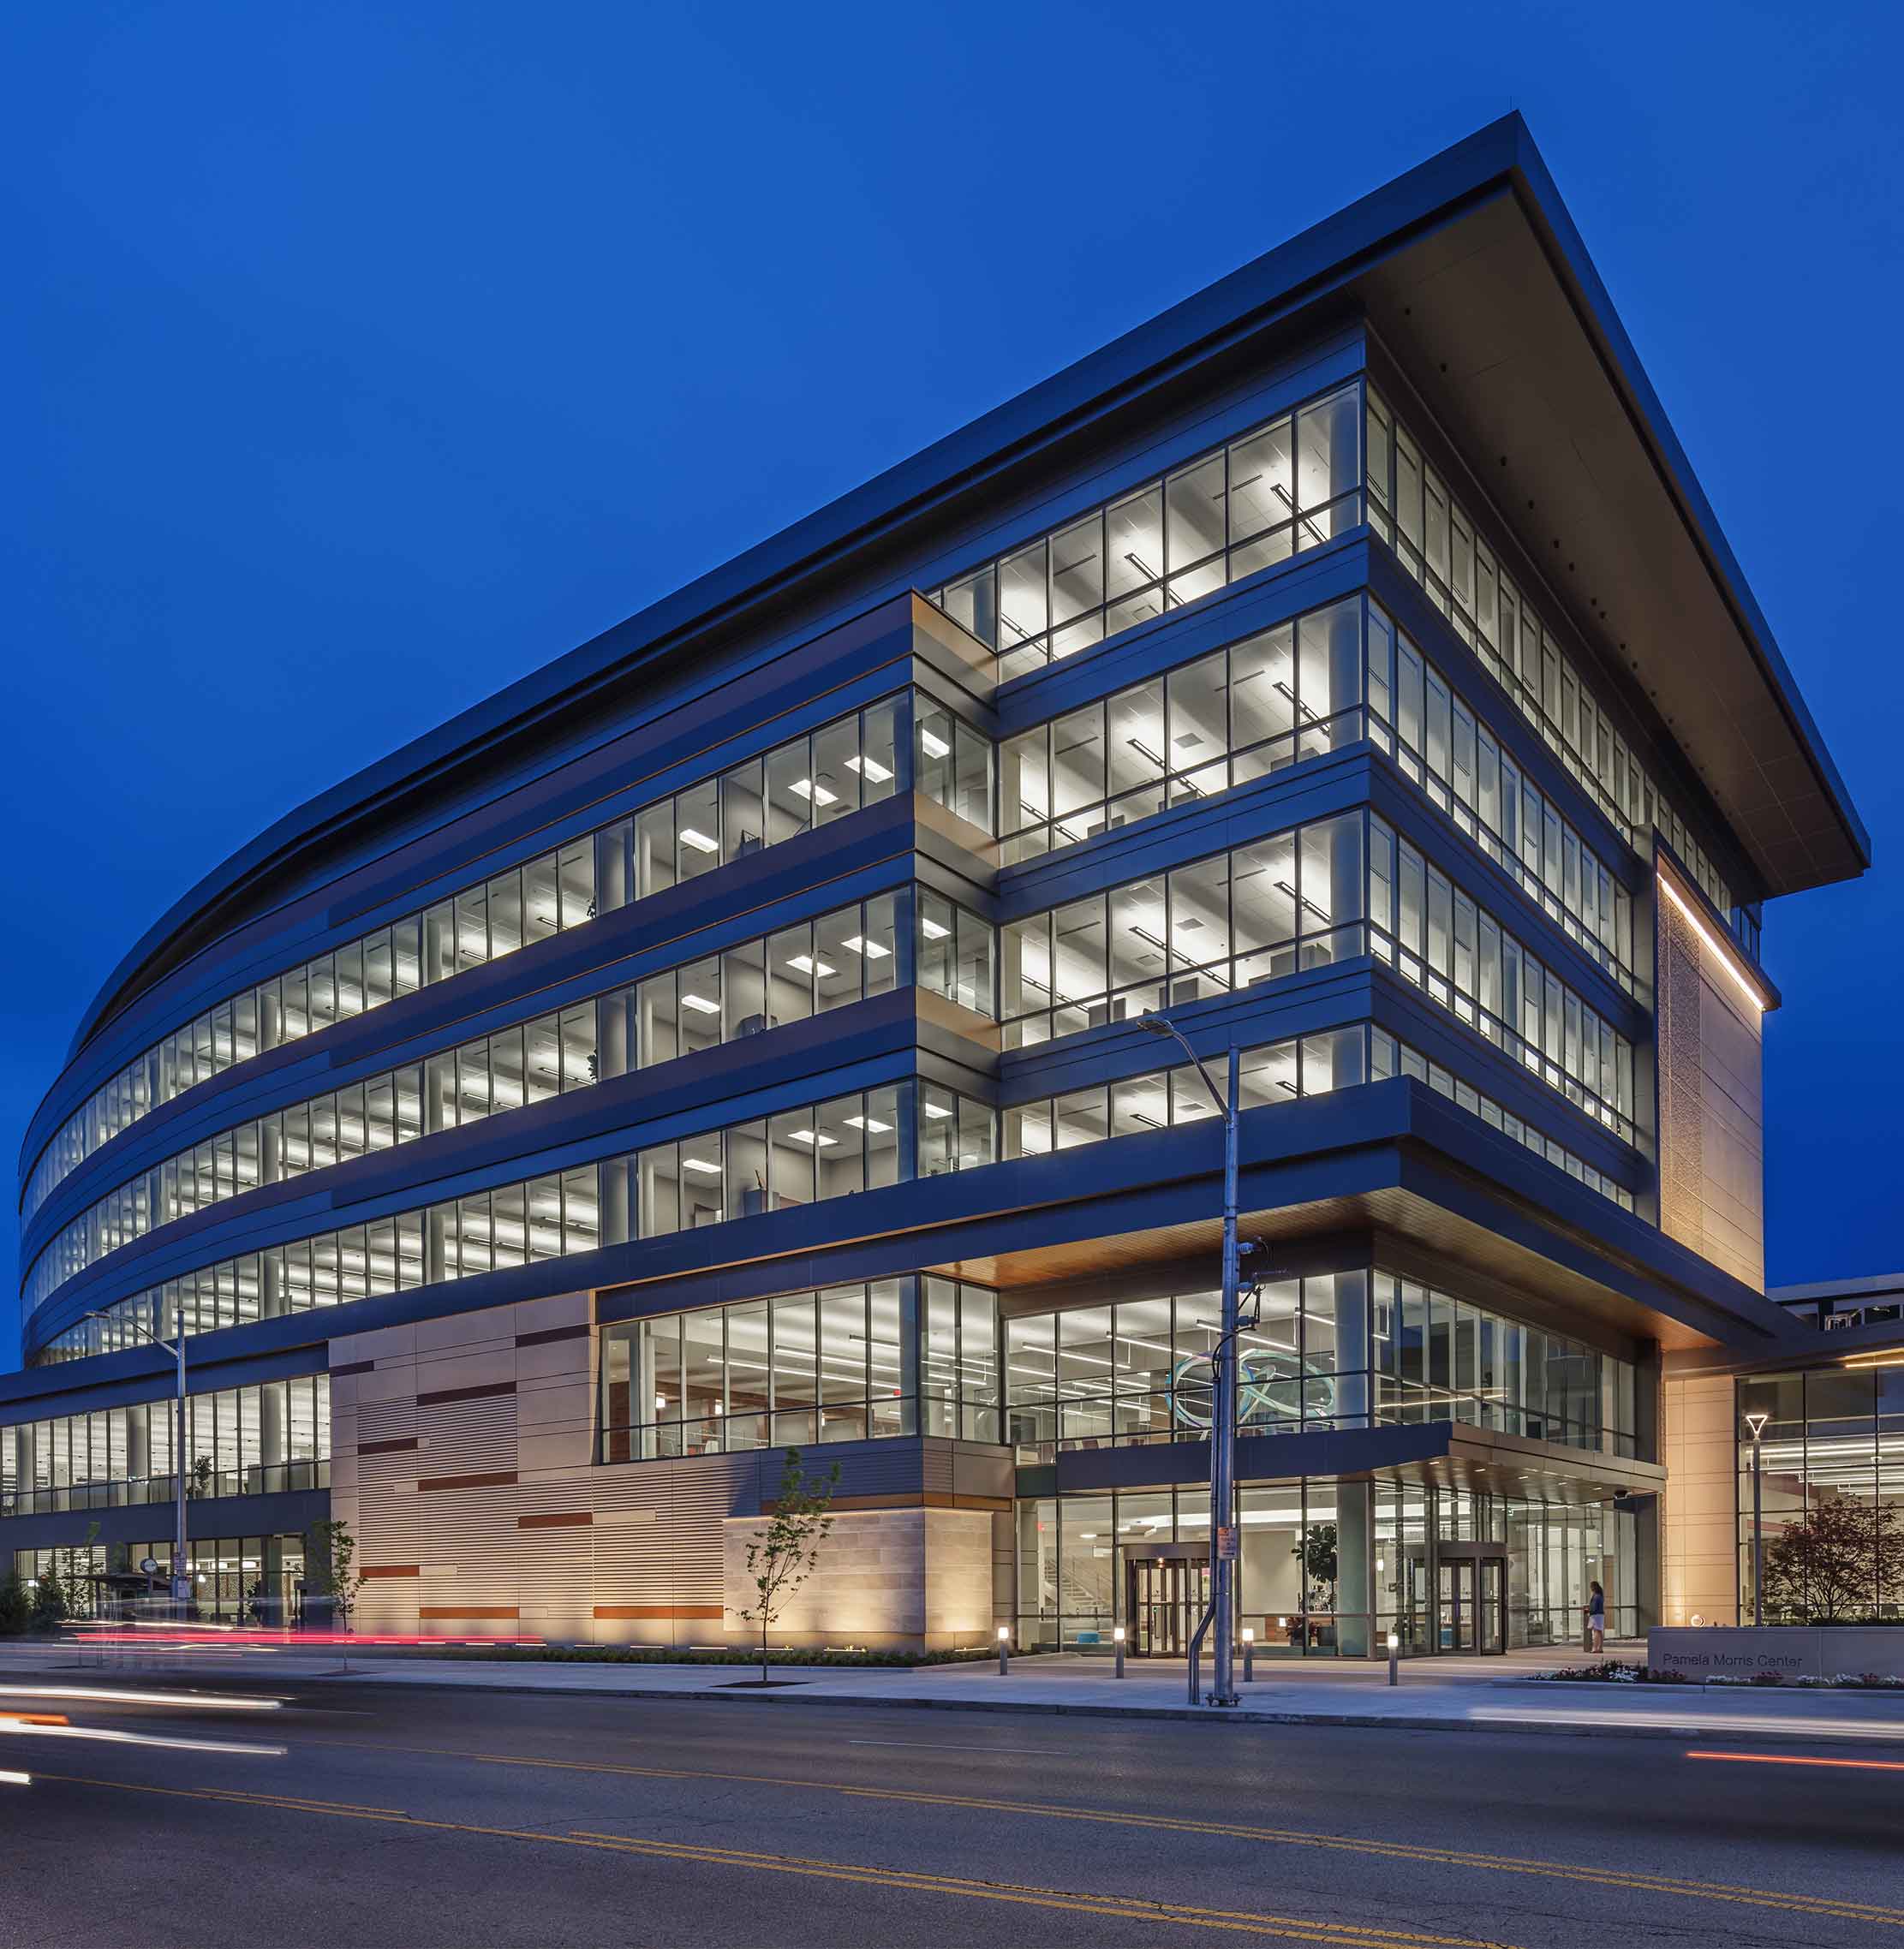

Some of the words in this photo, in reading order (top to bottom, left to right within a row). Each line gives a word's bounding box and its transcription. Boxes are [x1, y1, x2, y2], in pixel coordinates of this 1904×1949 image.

[1663, 1653, 1710, 1666] Pamela
[1713, 1653, 1754, 1666] Morris
[1758, 1654, 1803, 1667] Center
